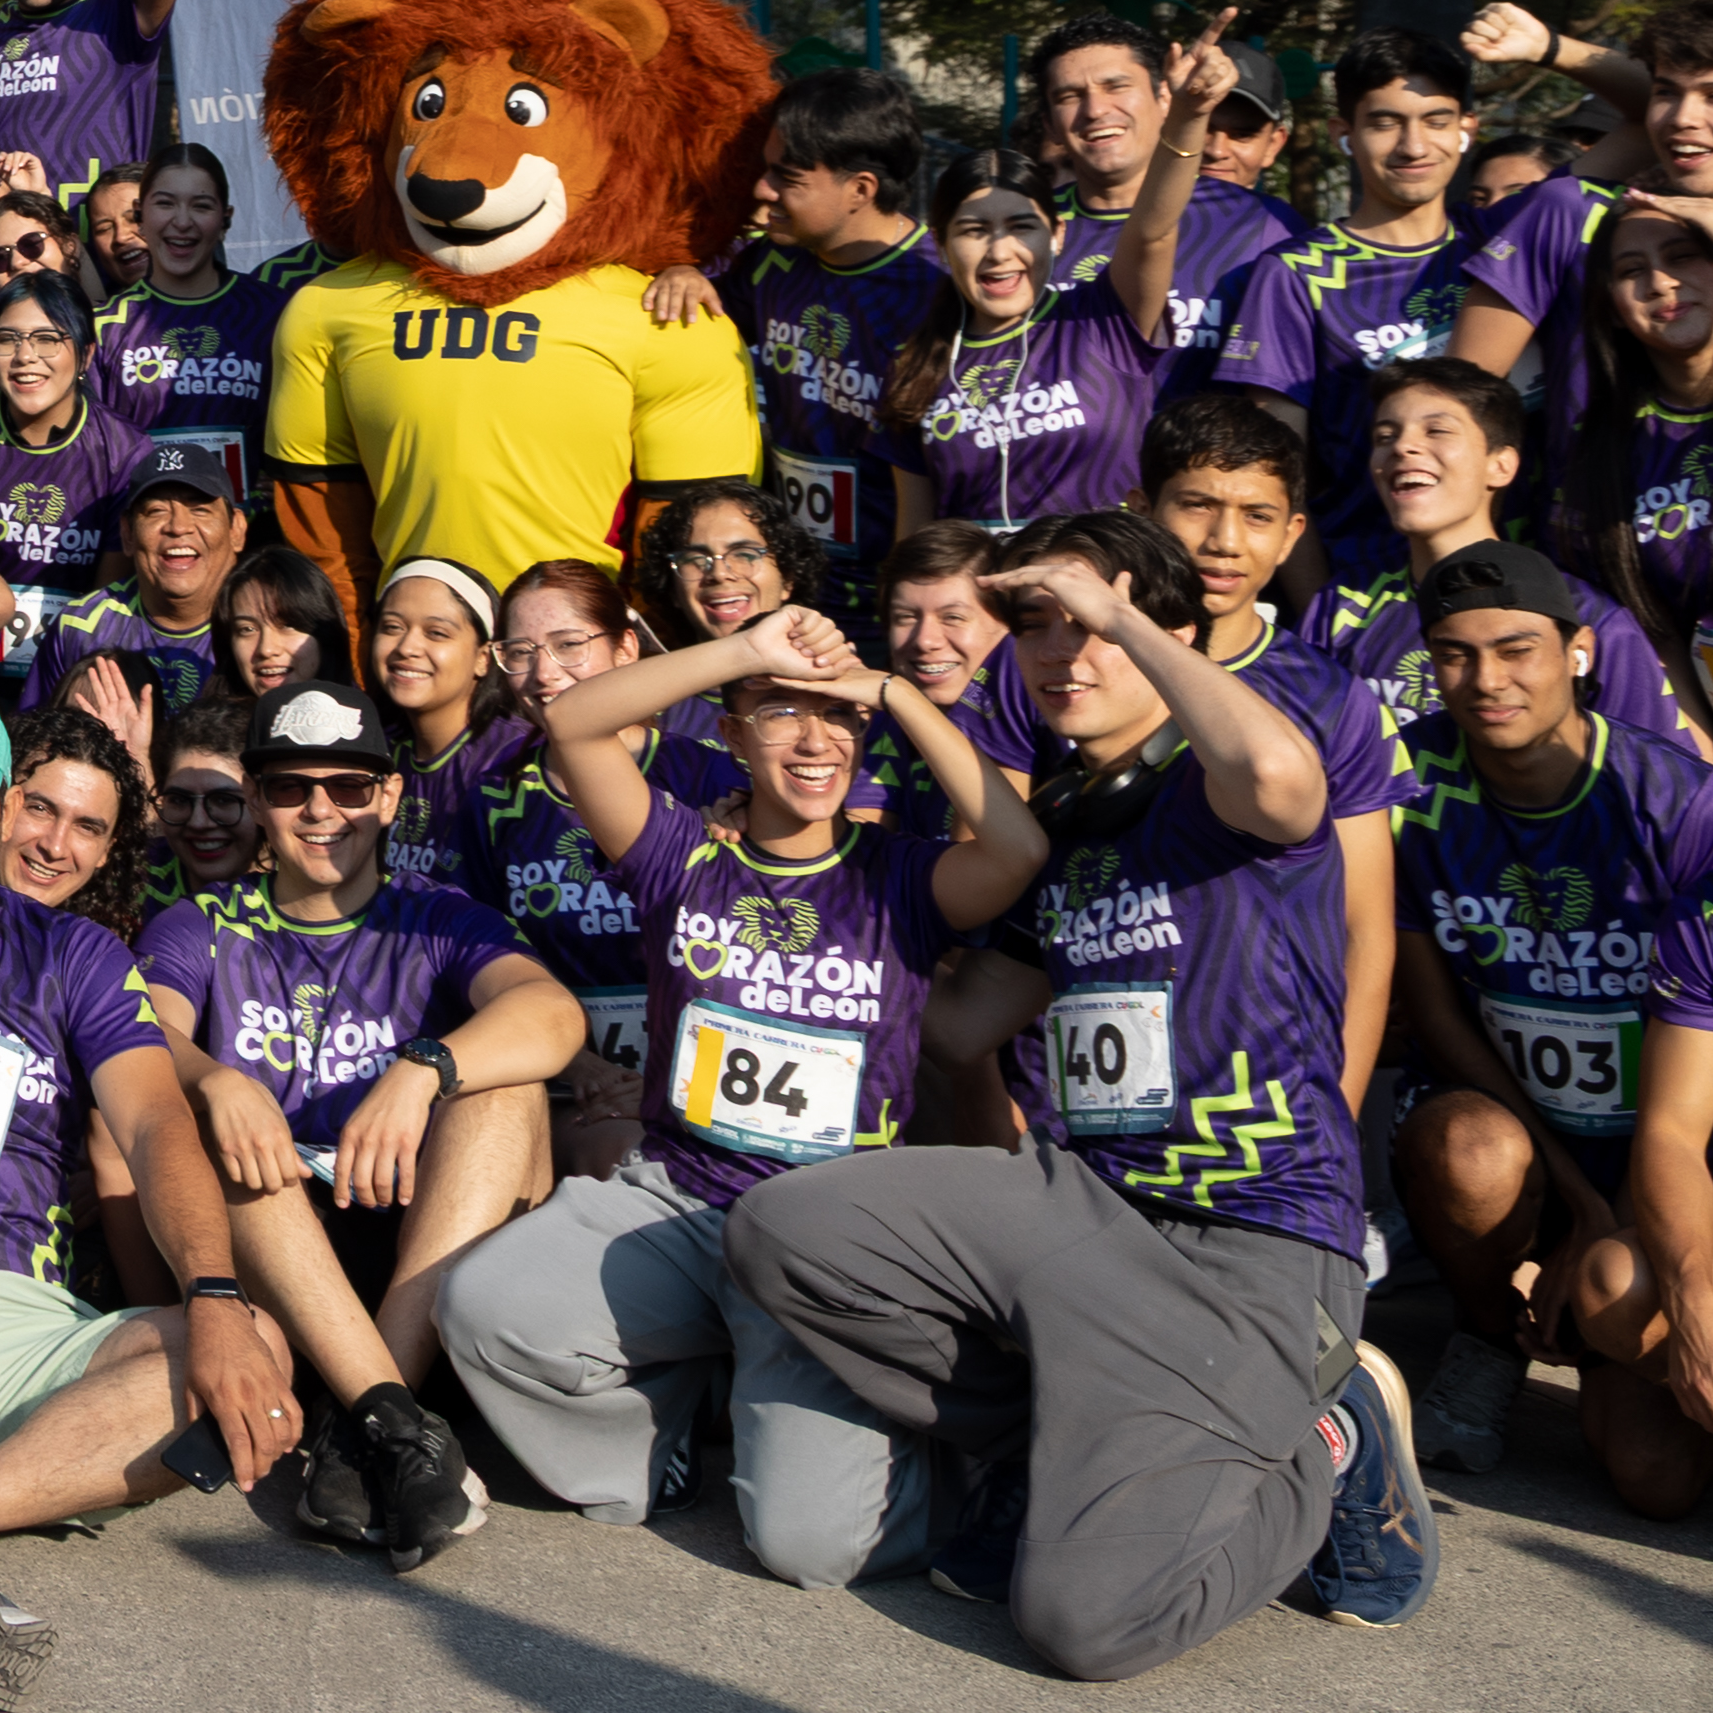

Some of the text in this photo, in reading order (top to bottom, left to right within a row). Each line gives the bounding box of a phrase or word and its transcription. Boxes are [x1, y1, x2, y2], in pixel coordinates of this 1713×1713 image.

[392, 307, 542, 365] UDG
[121, 350, 263, 387] CORAZÓN
[122, 345, 170, 367] SOY
[173, 375, 261, 402] deLeón
[506, 859, 568, 890] SOY
[676, 905, 741, 943] SOY
[1430, 889, 1514, 928] SOY
[1066, 919, 1183, 968] deLeón
[741, 978, 881, 1024] deLeón
[704, 1017, 751, 1039] PRIMERA
[753, 1032, 806, 1052] CARRERA
[1065, 1022, 1127, 1087] 40
[1500, 1028, 1618, 1095] 103
[720, 1047, 809, 1118] 84
